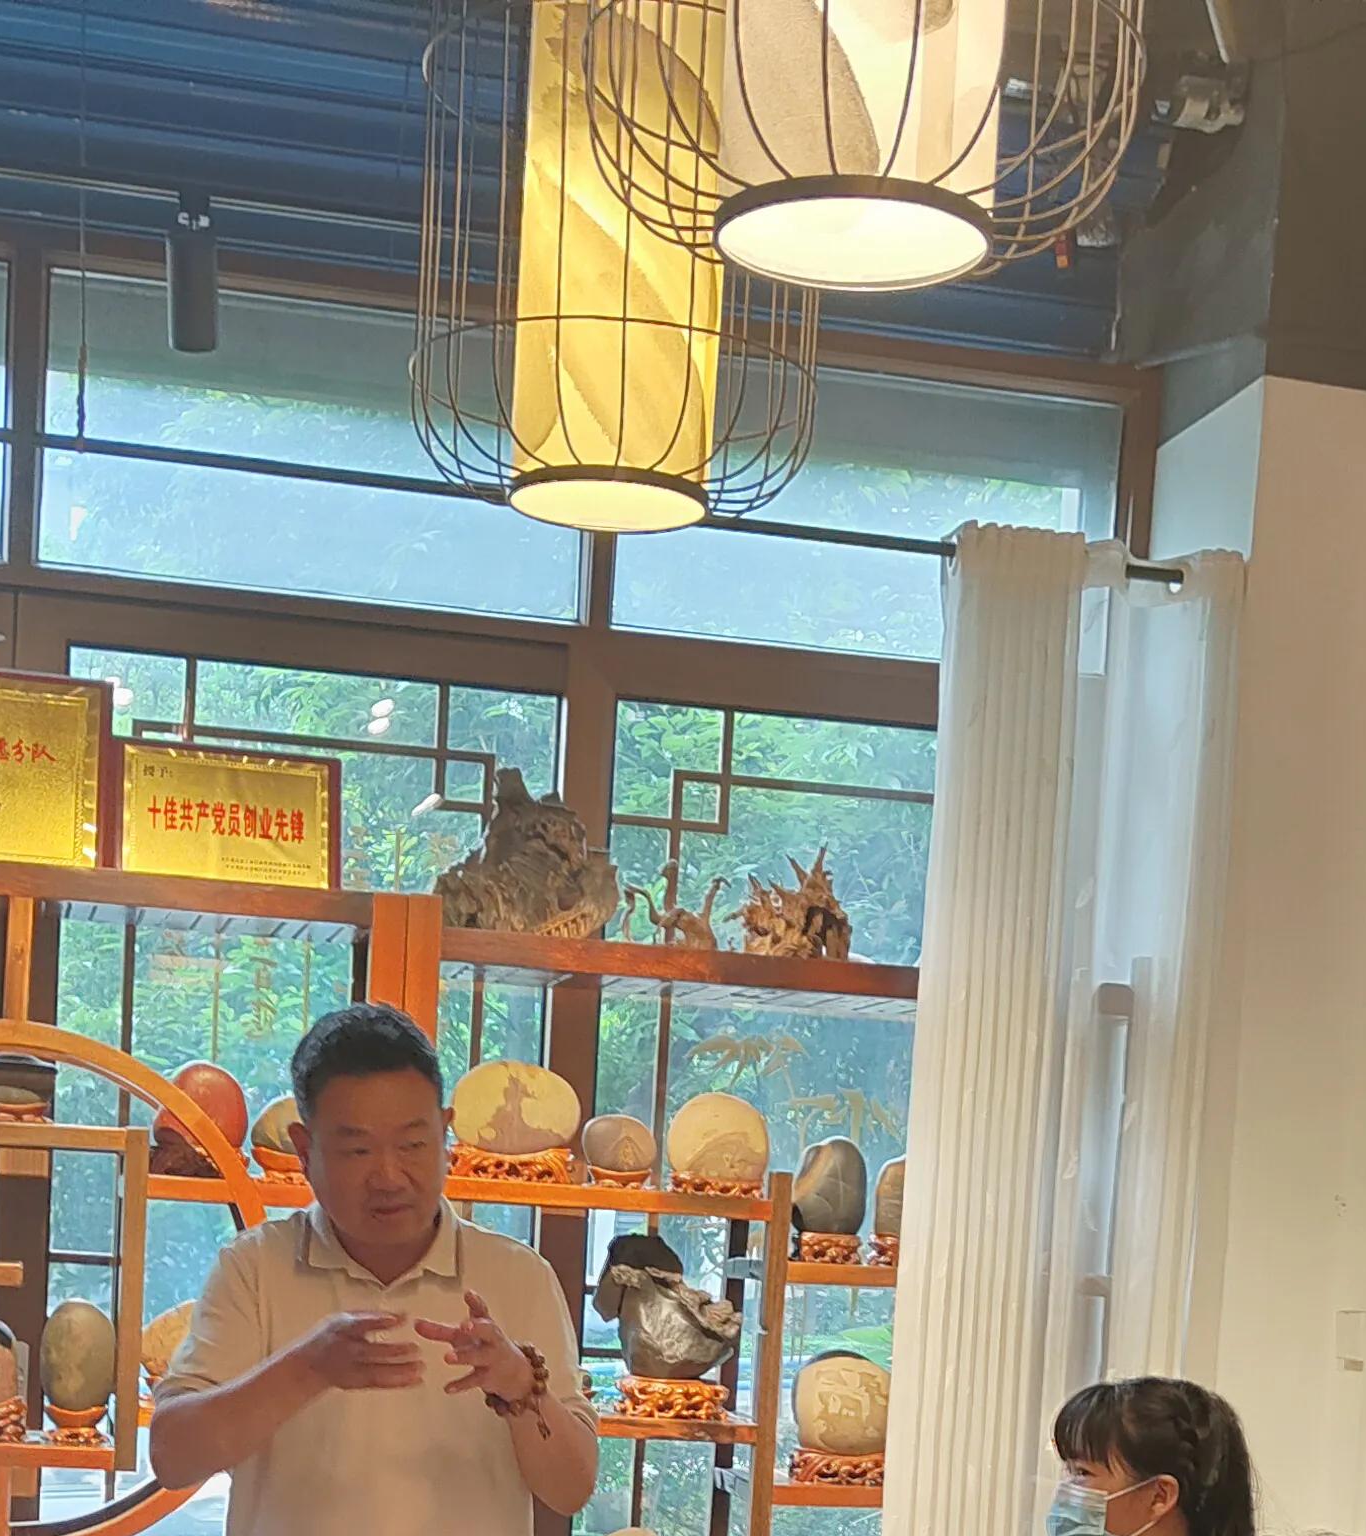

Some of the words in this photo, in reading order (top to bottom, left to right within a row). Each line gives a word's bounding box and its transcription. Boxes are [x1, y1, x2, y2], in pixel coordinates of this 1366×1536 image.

[147, 795, 305, 844] 十佳共产党员创业先锋
